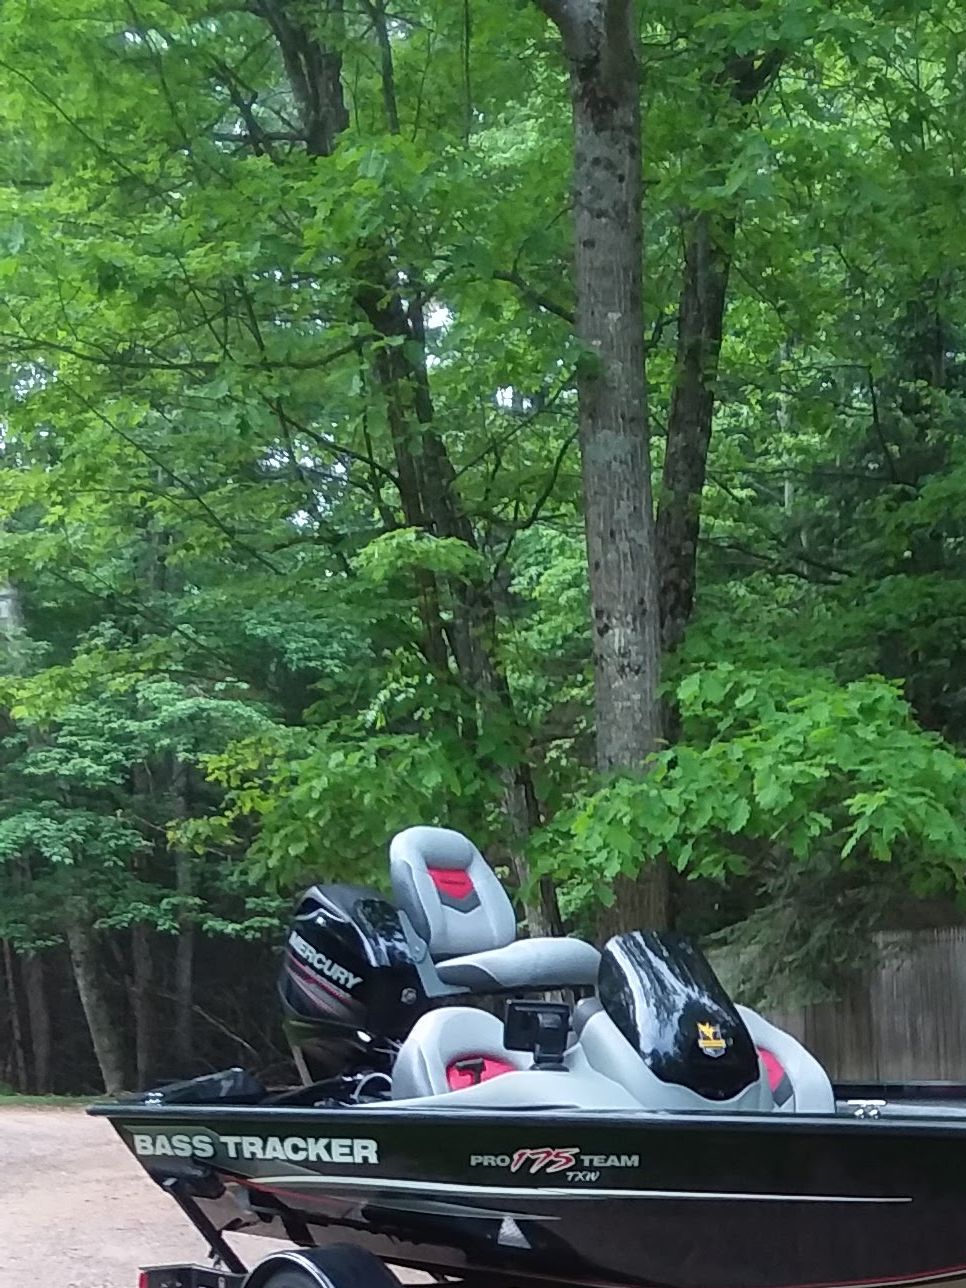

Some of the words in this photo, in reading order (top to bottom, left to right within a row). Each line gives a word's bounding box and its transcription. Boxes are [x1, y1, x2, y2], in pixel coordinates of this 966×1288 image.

[288, 930, 363, 989] MERCURY
[132, 1134, 214, 1158] BASS
[219, 1135, 379, 1164] TRACKER
[470, 1155, 510, 1167] PRO
[510, 1147, 580, 1173] 175
[580, 1155, 639, 1167] TEAM
[566, 1171, 600, 1182] TXW
